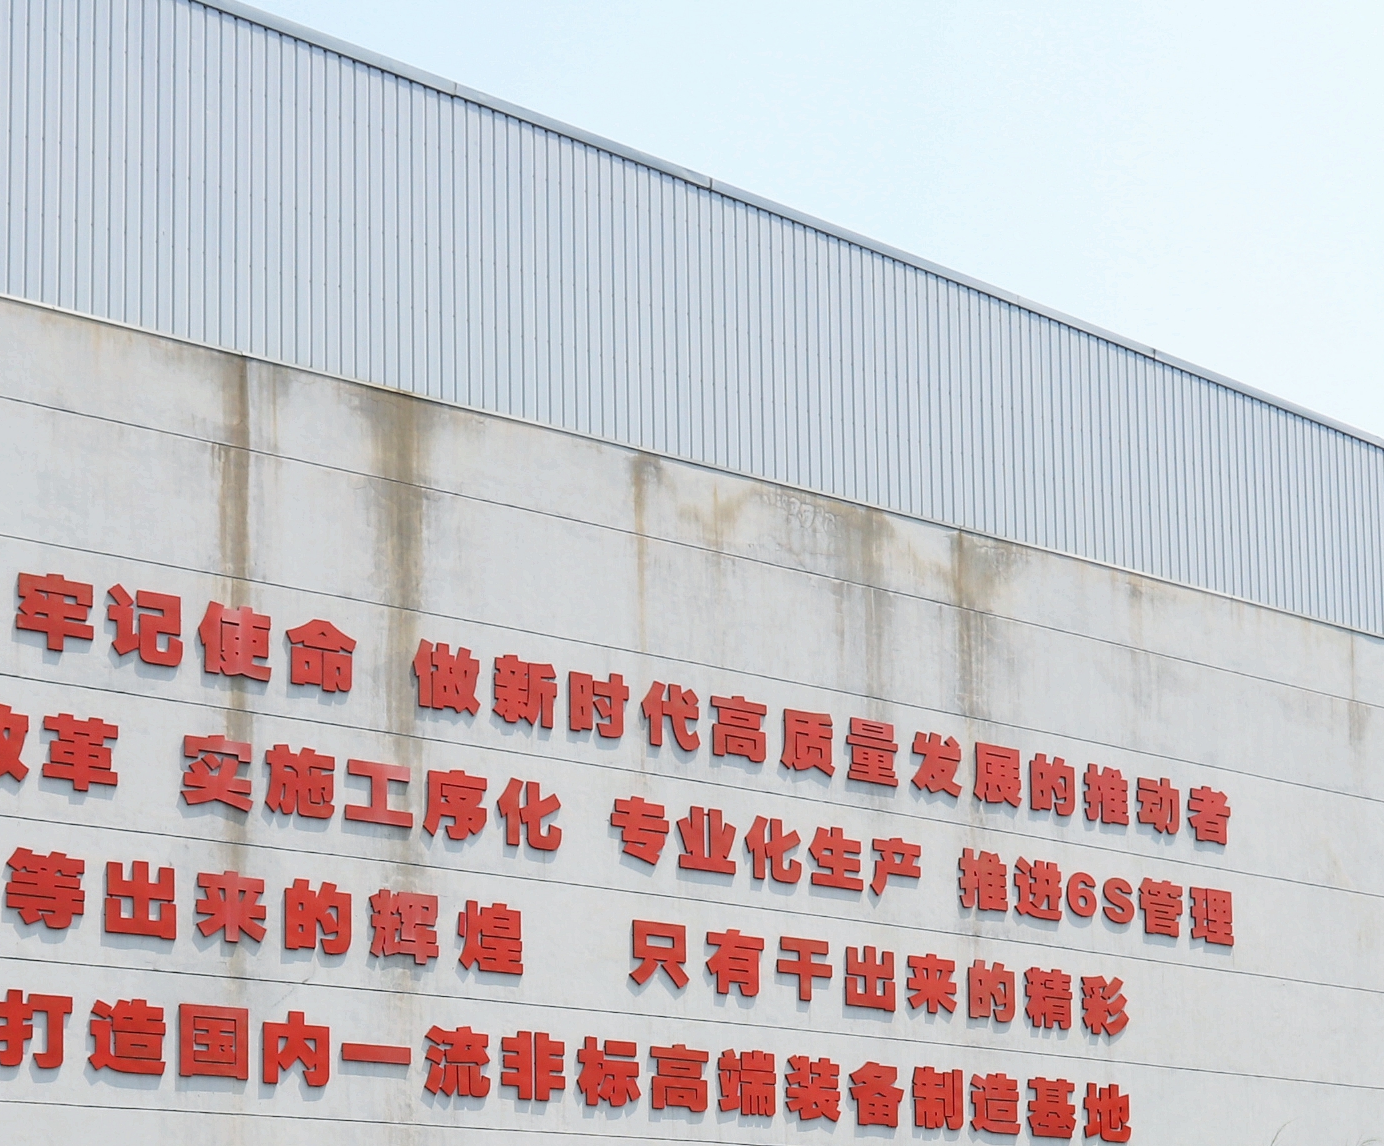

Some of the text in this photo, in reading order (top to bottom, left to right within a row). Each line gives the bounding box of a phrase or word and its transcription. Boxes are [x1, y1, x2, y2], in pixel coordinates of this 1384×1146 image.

[17, 573, 355, 690] 牢记使命
[413, 640, 1229, 843] 做新时代高质量发展的推动者
[182, 736, 560, 849] 实施工序化
[611, 797, 919, 893] 专业化生产
[962, 849, 1232, 945] 推进6S管理
[631, 920, 1128, 1033] 只有干出来的精彩
